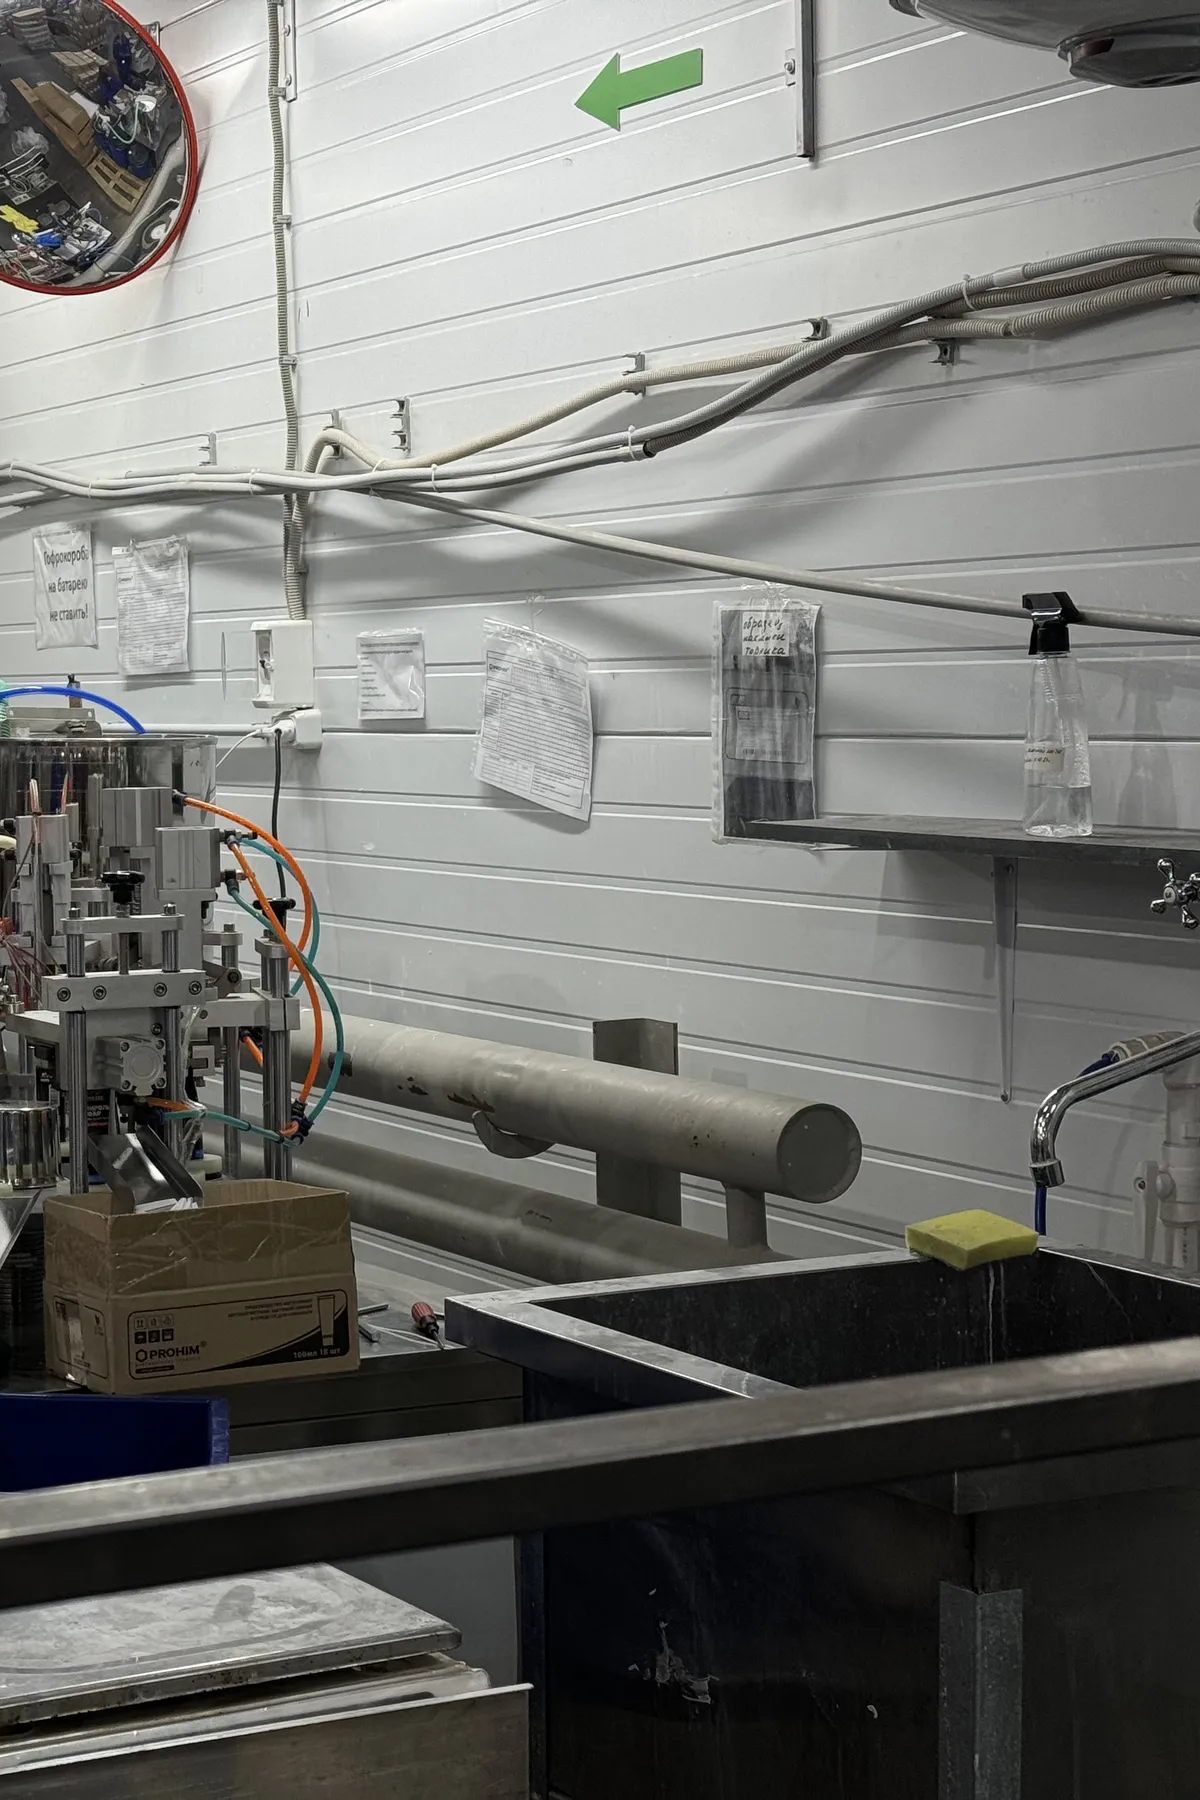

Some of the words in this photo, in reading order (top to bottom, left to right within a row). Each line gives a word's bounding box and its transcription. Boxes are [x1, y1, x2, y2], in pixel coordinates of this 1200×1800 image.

[43, 544, 89, 568] Гофрокороба
[48, 581, 57, 593] на
[58, 577, 88, 594] батарею
[49, 609, 58, 622] не
[59, 603, 88, 621] ставить!
[149, 1344, 200, 1360] PROHIM
